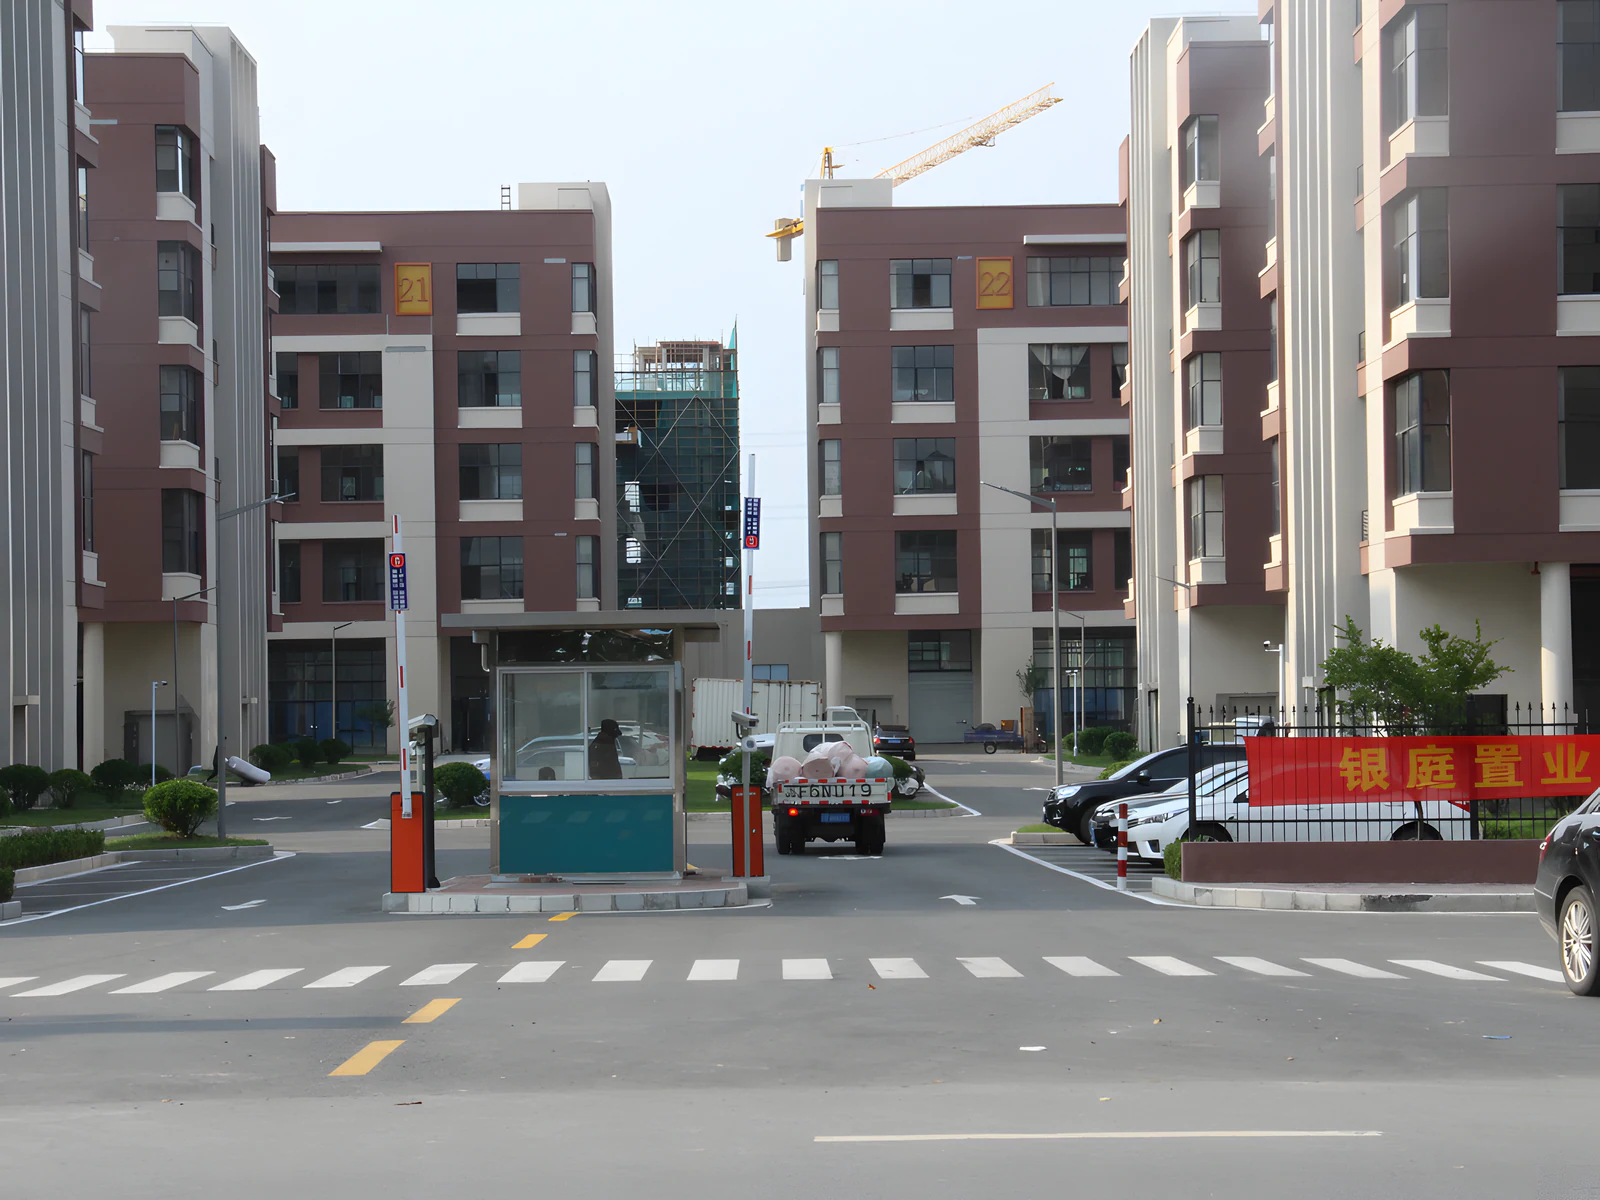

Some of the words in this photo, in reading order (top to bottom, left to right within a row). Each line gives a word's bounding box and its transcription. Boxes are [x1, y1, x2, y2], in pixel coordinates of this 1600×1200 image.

[398, 277, 428, 303] 21
[980, 271, 1010, 297] 22
[1339, 743, 1592, 792] 银庭置业
